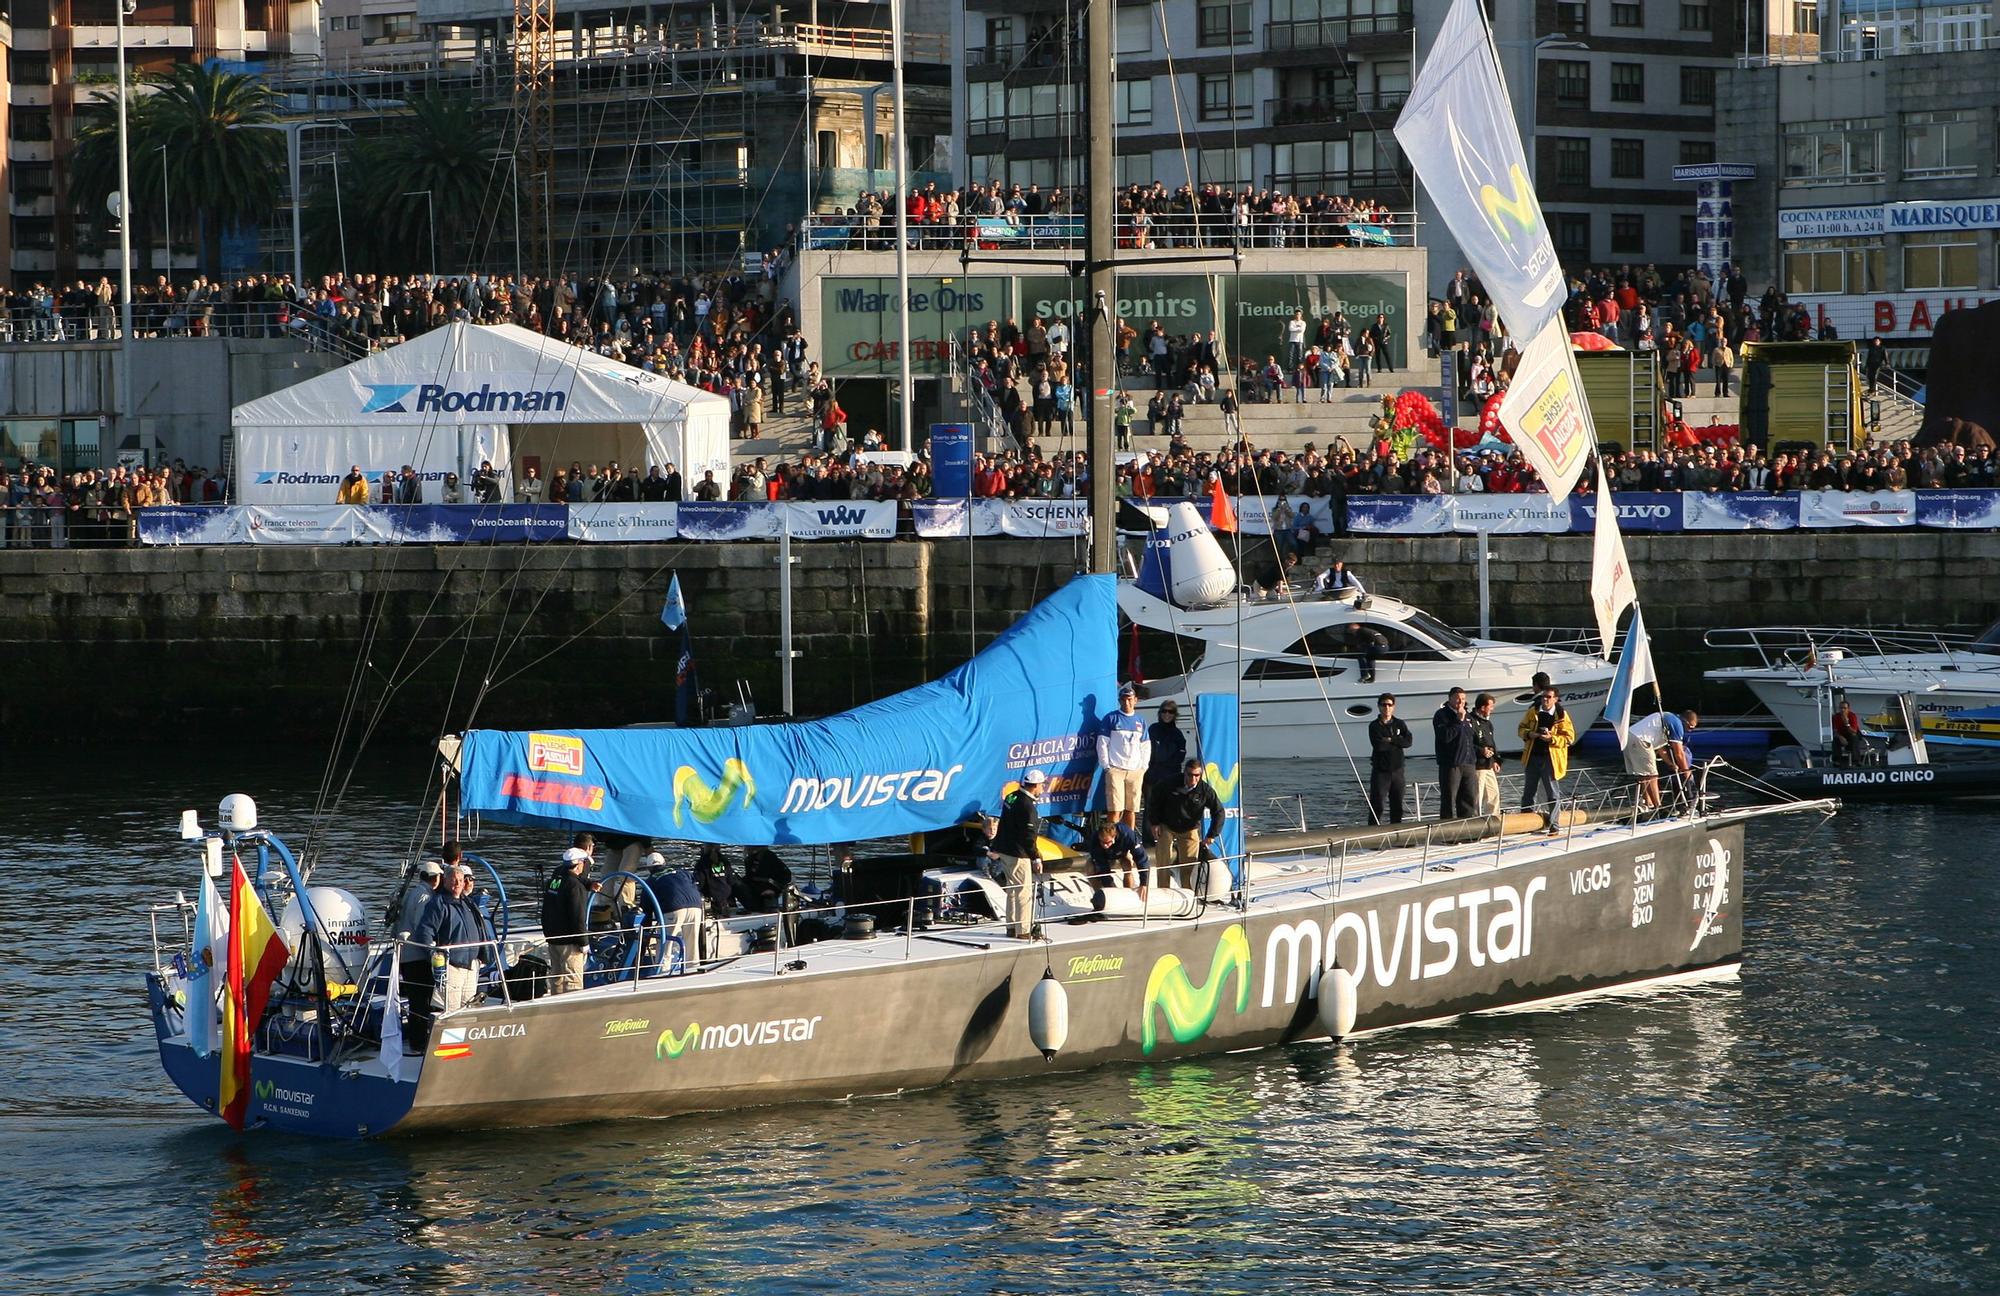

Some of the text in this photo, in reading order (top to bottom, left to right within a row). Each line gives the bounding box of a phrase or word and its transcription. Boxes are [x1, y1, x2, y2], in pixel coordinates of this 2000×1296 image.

[1674, 166, 1719, 177] MARISQUERIA
[1721, 166, 1755, 176] MARISQUERIA
[1781, 210, 1824, 223] COCINA
[1891, 203, 2000, 227] MARISQUE
[1795, 224, 1814, 235] DE:
[1816, 222, 1841, 234] 11:00
[1855, 222, 1862, 232] A
[1863, 221, 1875, 232] 24
[938, 287, 984, 312] Ons
[1036, 291, 1198, 319] soenirs
[1235, 300, 1396, 318] Tiendas de Regalo
[415, 383, 566, 413] Rodman
[277, 471, 340, 484] Rodman
[572, 516, 675, 528] Thrane & Thrane
[1457, 508, 1568, 520] Thrane & Thrane
[264, 519, 319, 527] france telecom
[471, 517, 565, 529] VolvoOceanRace.org
[791, 528, 891, 537] WALLENIUS WILHELMSEN
[1916, 702, 1965, 713] odman
[1009, 738, 1065, 759] GALICIA
[1822, 769, 1935, 785] MARIAJO CINCO
[779, 764, 963, 814] movistar
[1695, 849, 1731, 869] VOLO
[1633, 862, 1656, 884] SAN
[1693, 868, 1730, 889] OCEN
[1632, 883, 1655, 906] XEN
[327, 918, 366, 928] inmarsat
[1260, 876, 1547, 1009] movistar
[468, 1023, 526, 1042] GALICIA
[700, 1016, 822, 1051] movistar
[275, 1088, 316, 1105] movistar
